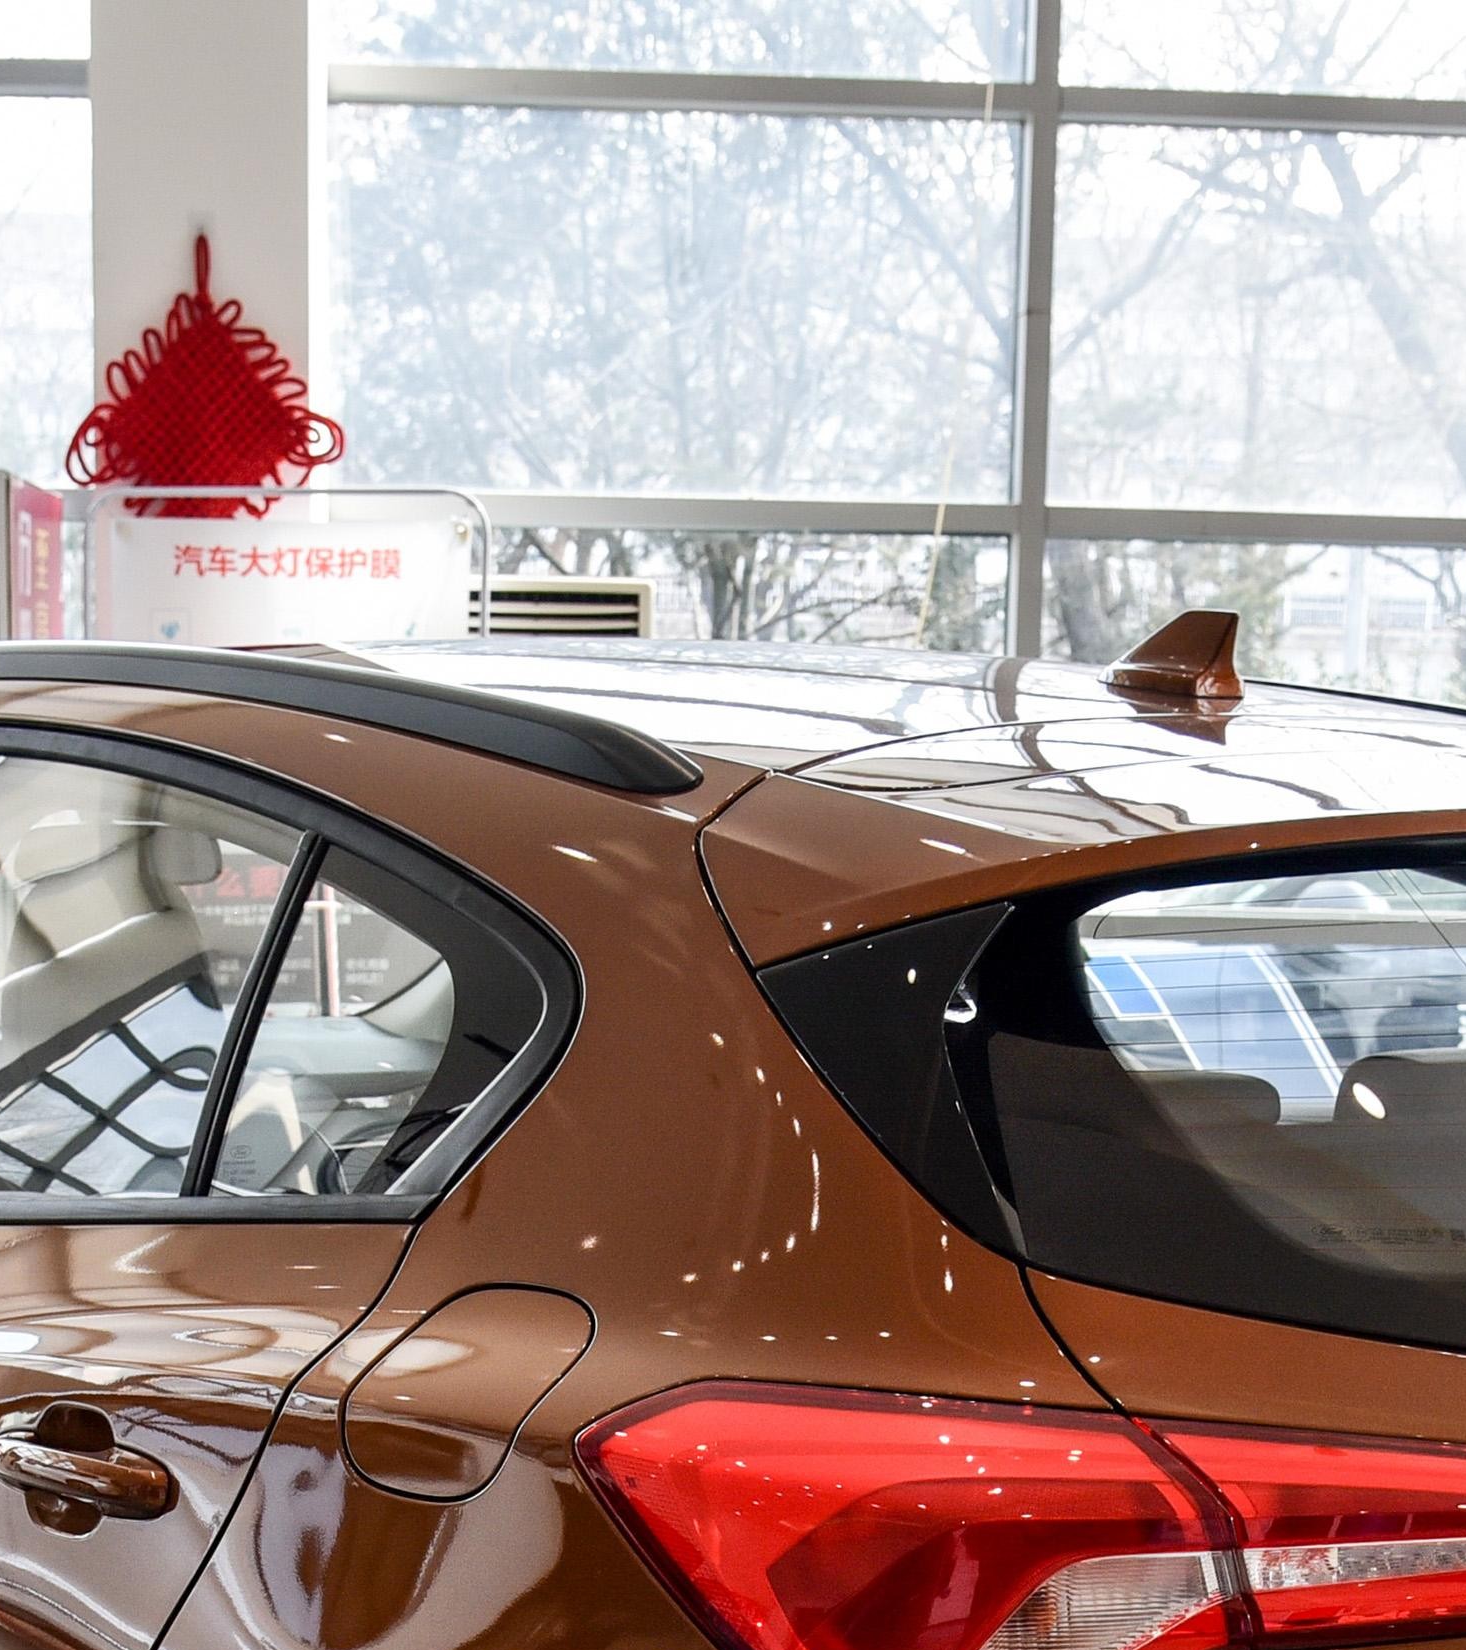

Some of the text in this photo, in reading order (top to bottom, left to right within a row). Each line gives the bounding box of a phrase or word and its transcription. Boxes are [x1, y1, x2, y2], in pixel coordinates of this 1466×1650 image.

[174, 545, 401, 579] 汽车大灯保护膜
